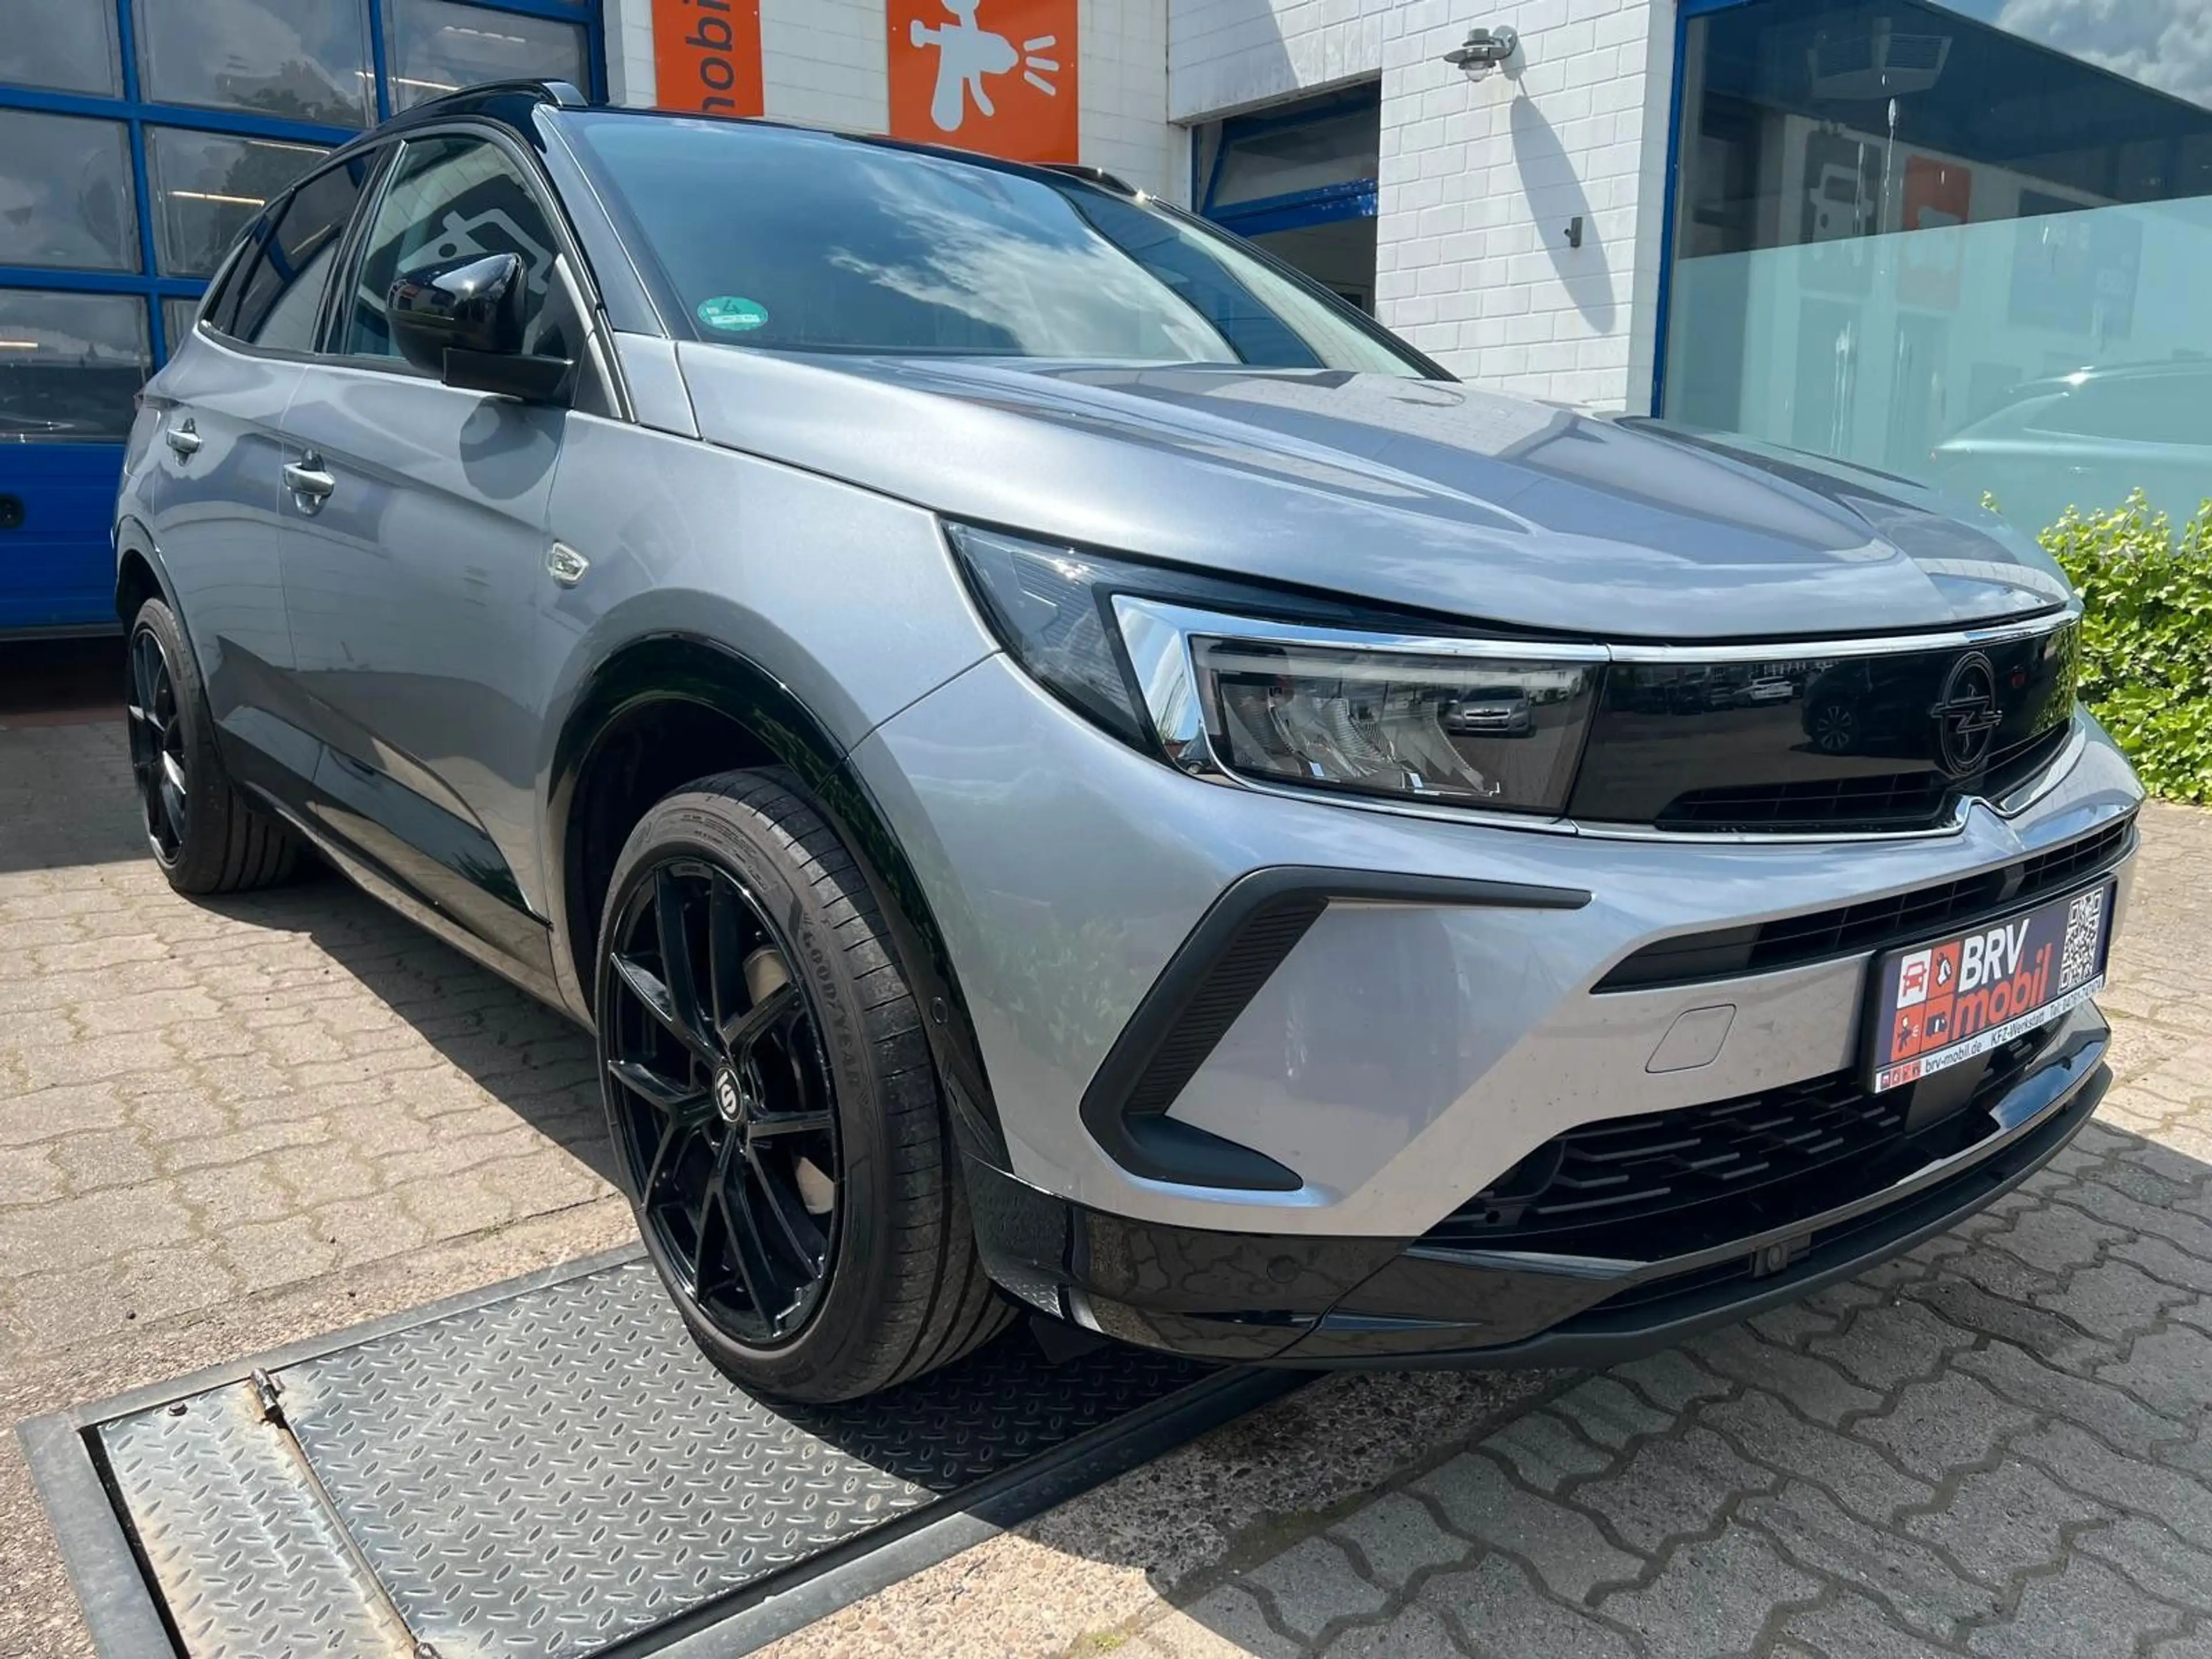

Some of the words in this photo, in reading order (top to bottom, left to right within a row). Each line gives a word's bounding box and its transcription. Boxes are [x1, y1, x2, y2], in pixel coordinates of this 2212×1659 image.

[1952, 942, 2052, 1039] mobil
[1959, 918, 2031, 993] BRV
[1925, 1040, 1982, 1073] brv-mobil.de
[1991, 1009, 2044, 1046] KFZ-Werkstatt
